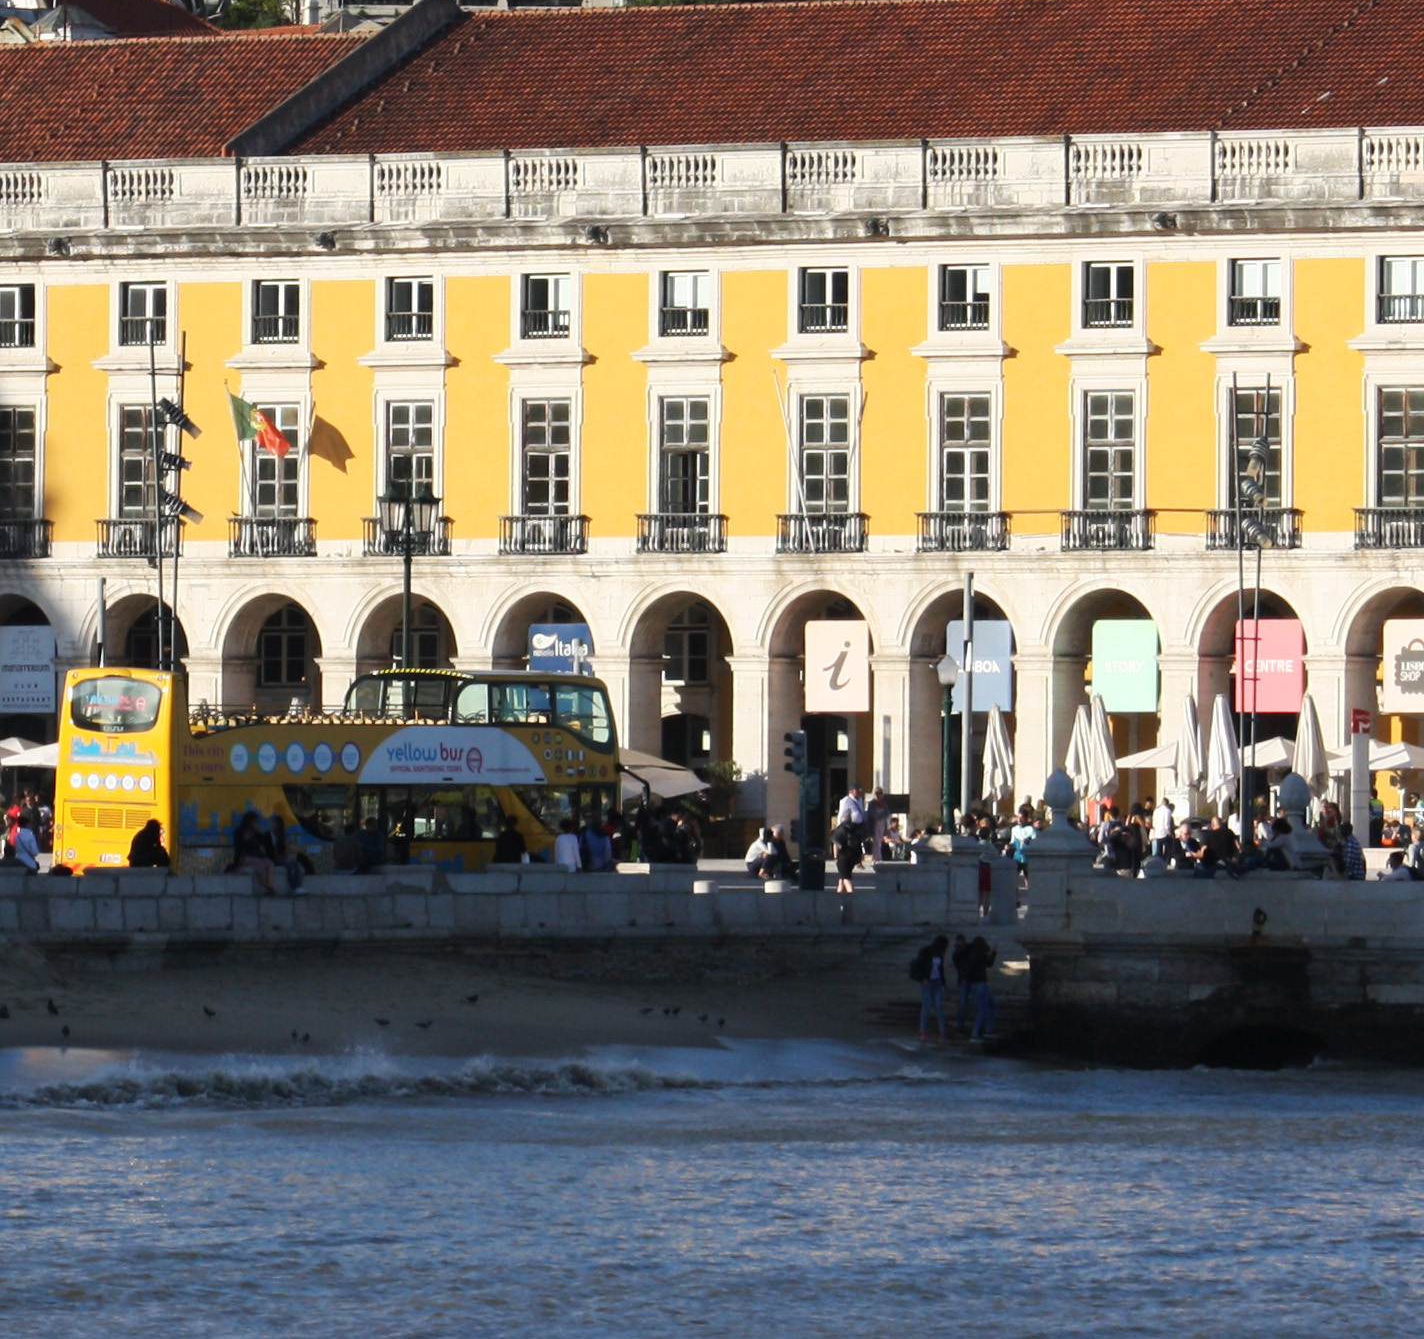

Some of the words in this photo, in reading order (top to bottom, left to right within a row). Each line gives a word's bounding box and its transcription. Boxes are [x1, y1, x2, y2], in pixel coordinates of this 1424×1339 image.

[1105, 660, 1144, 673] STORY
[1244, 660, 1293, 673] CENTRE
[1400, 671, 1421, 681] SHOP
[387, 742, 438, 761] yellow
[440, 742, 464, 761] bus
